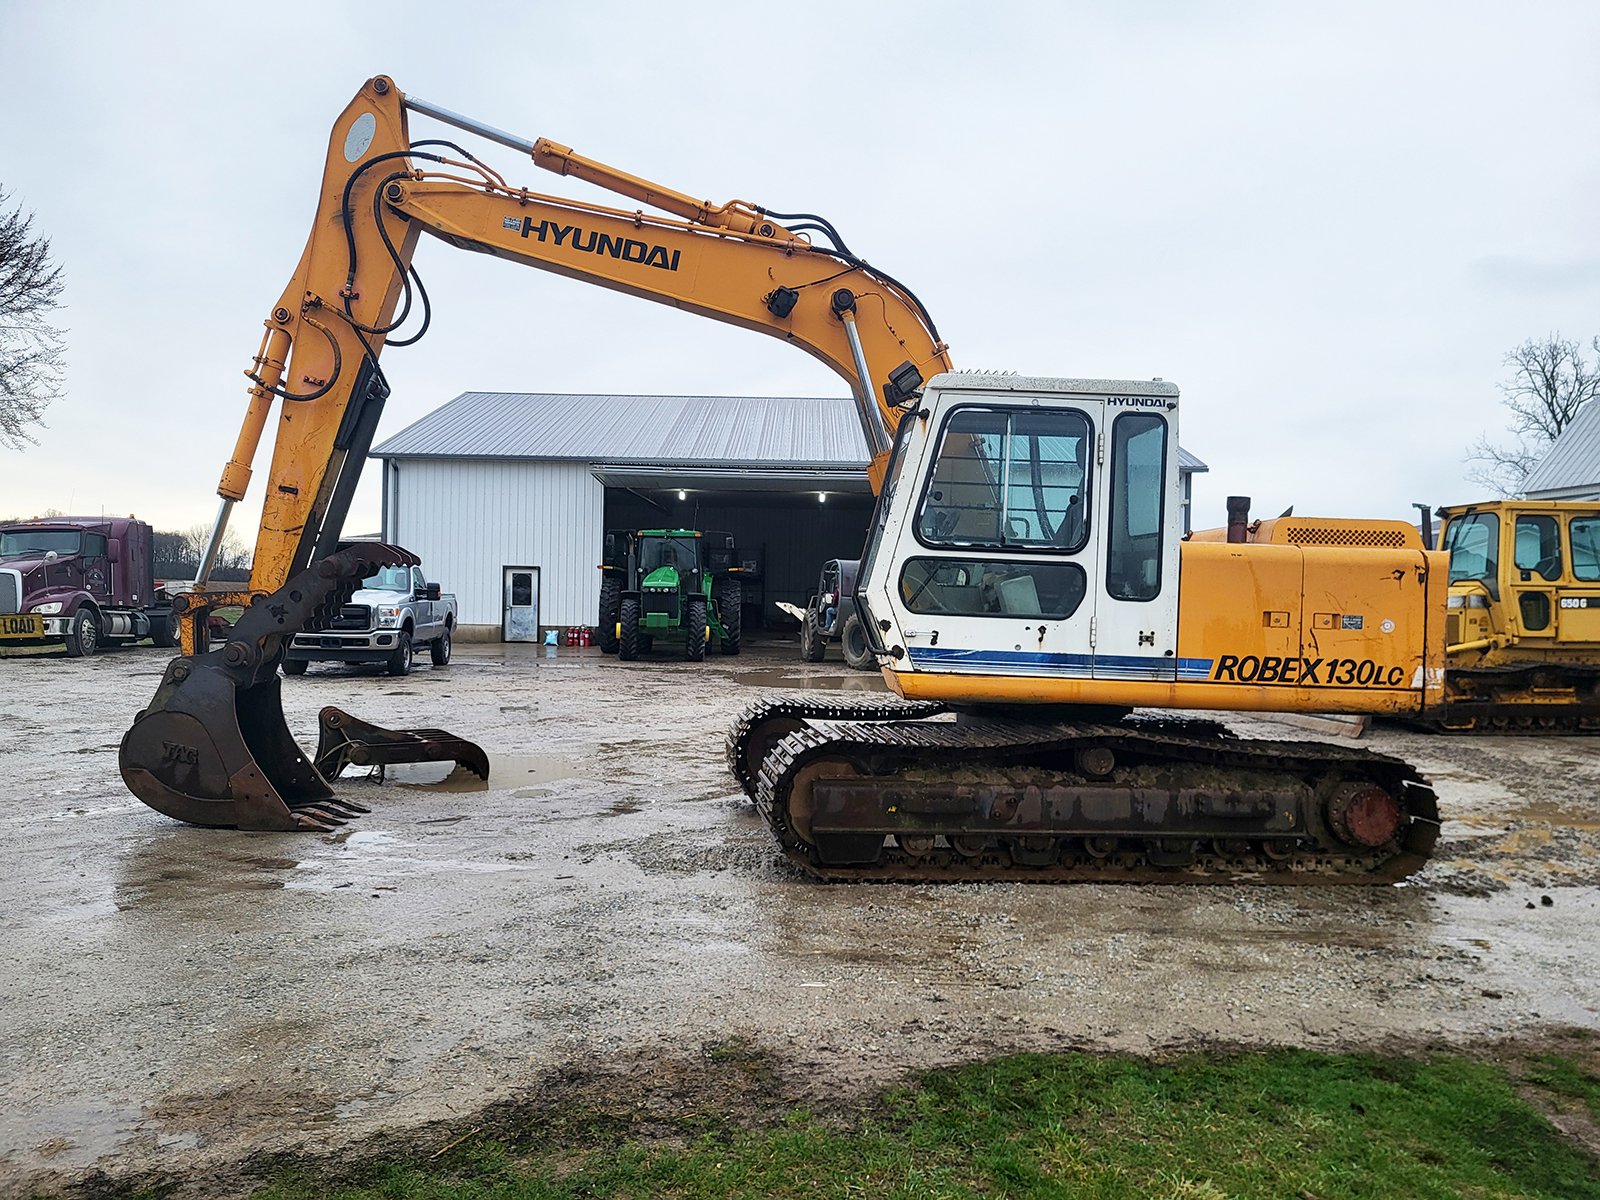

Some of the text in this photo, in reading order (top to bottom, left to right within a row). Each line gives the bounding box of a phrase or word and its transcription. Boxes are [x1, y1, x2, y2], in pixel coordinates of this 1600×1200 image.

[520, 216, 681, 272] HYUNDAI
[1107, 397, 1166, 408] HYUNDAI
[3, 617, 36, 635] LOAD
